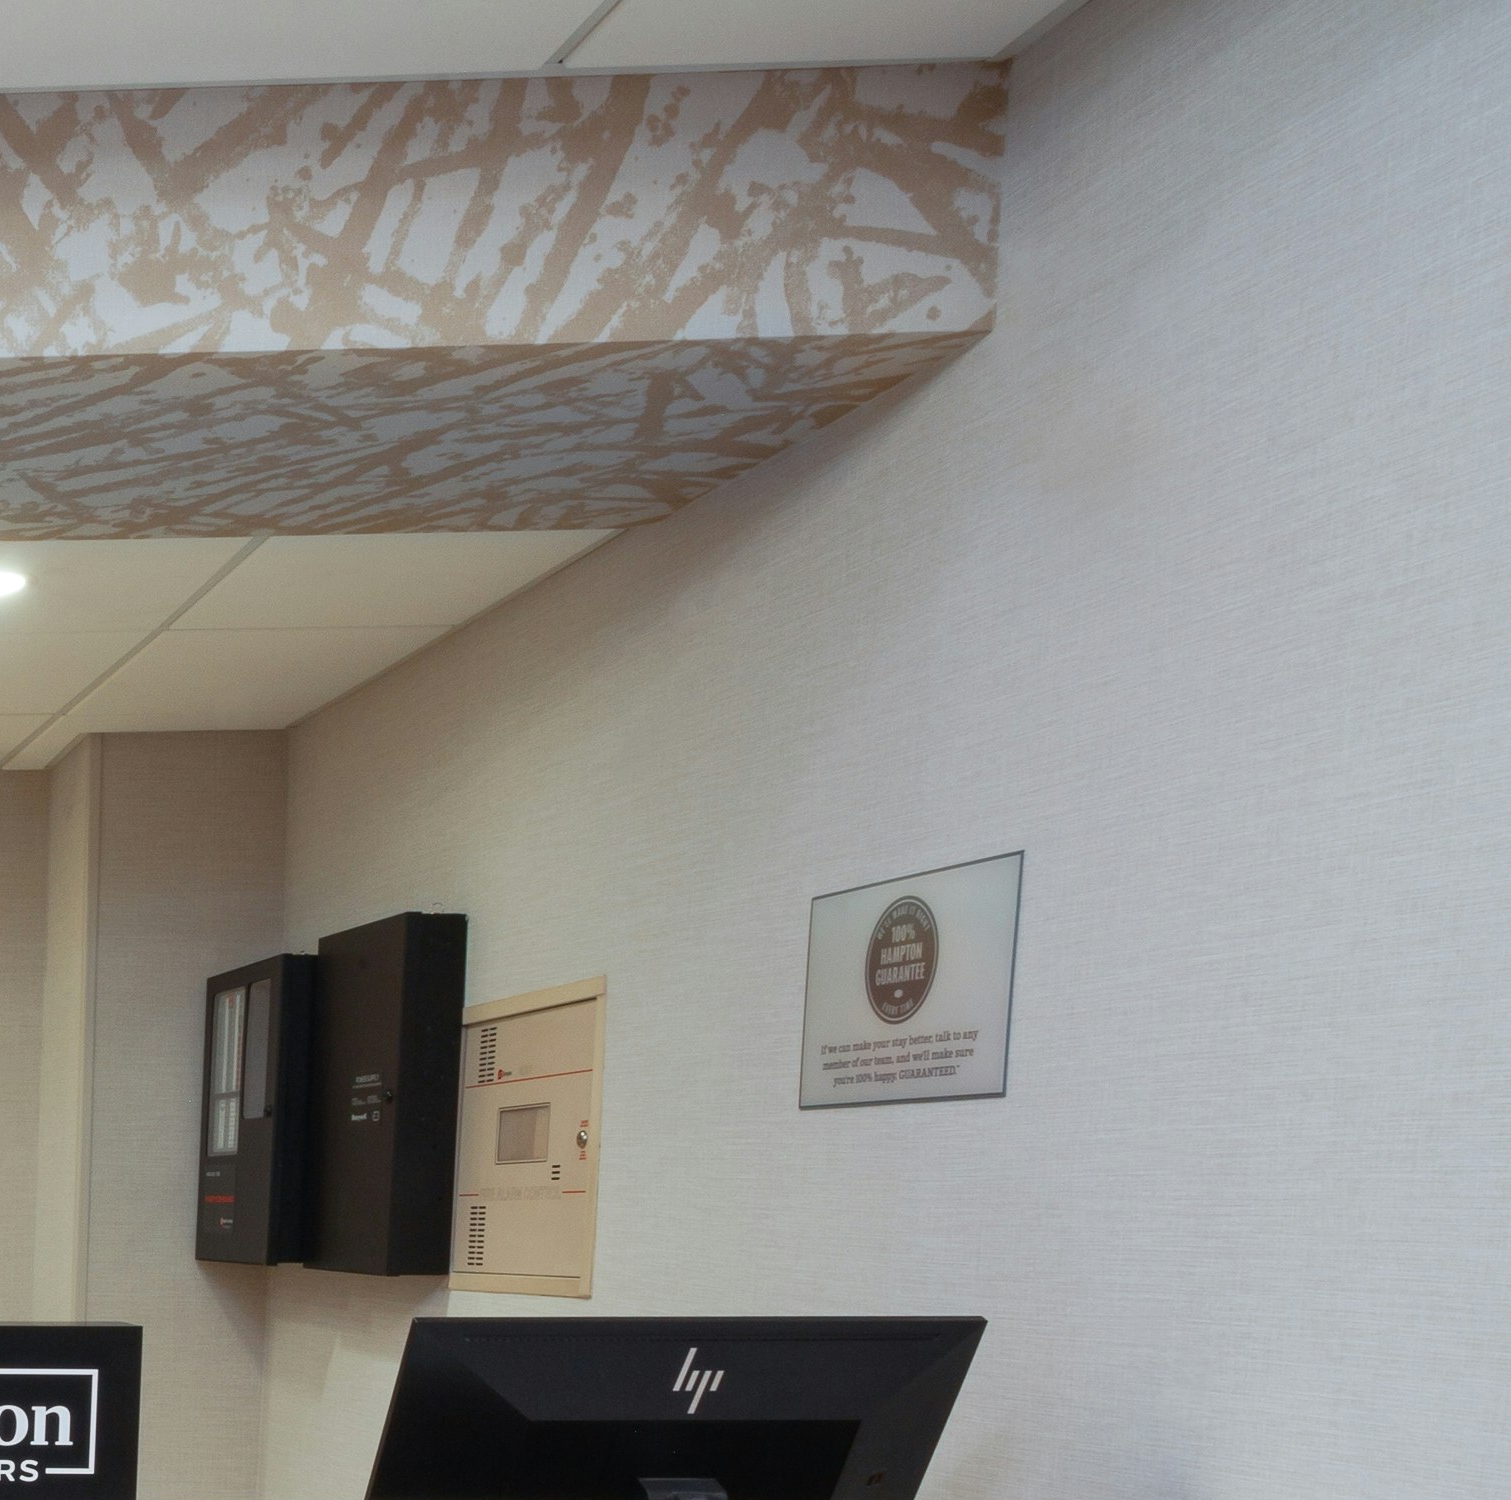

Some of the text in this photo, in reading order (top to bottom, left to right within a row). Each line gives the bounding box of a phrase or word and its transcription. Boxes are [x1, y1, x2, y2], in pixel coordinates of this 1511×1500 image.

[891, 922, 916, 943] 100%
[880, 942, 923, 966] HAMPTON
[875, 962, 926, 986] GUARANTEE
[828, 1046, 838, 1054] we
[838, 1044, 851, 1053] can
[852, 1040, 872, 1051] make
[873, 1040, 890, 1052] your
[892, 1036, 907, 1048] stay
[935, 1030, 951, 1042] talk
[952, 1031, 962, 1041] to
[962, 1029, 979, 1042] any
[822, 1058, 851, 1070] member
[852, 1056, 860, 1068] of
[860, 1058, 874, 1067] our
[896, 1051, 910, 1063] and
[912, 1049, 930, 1061] we'll
[931, 1048, 954, 1060] make
[954, 1048, 975, 1058] sure
[833, 1075, 855, 1088] you're
[855, 1073, 873, 1084] 100%
[672, 1347, 725, 1415] hp
